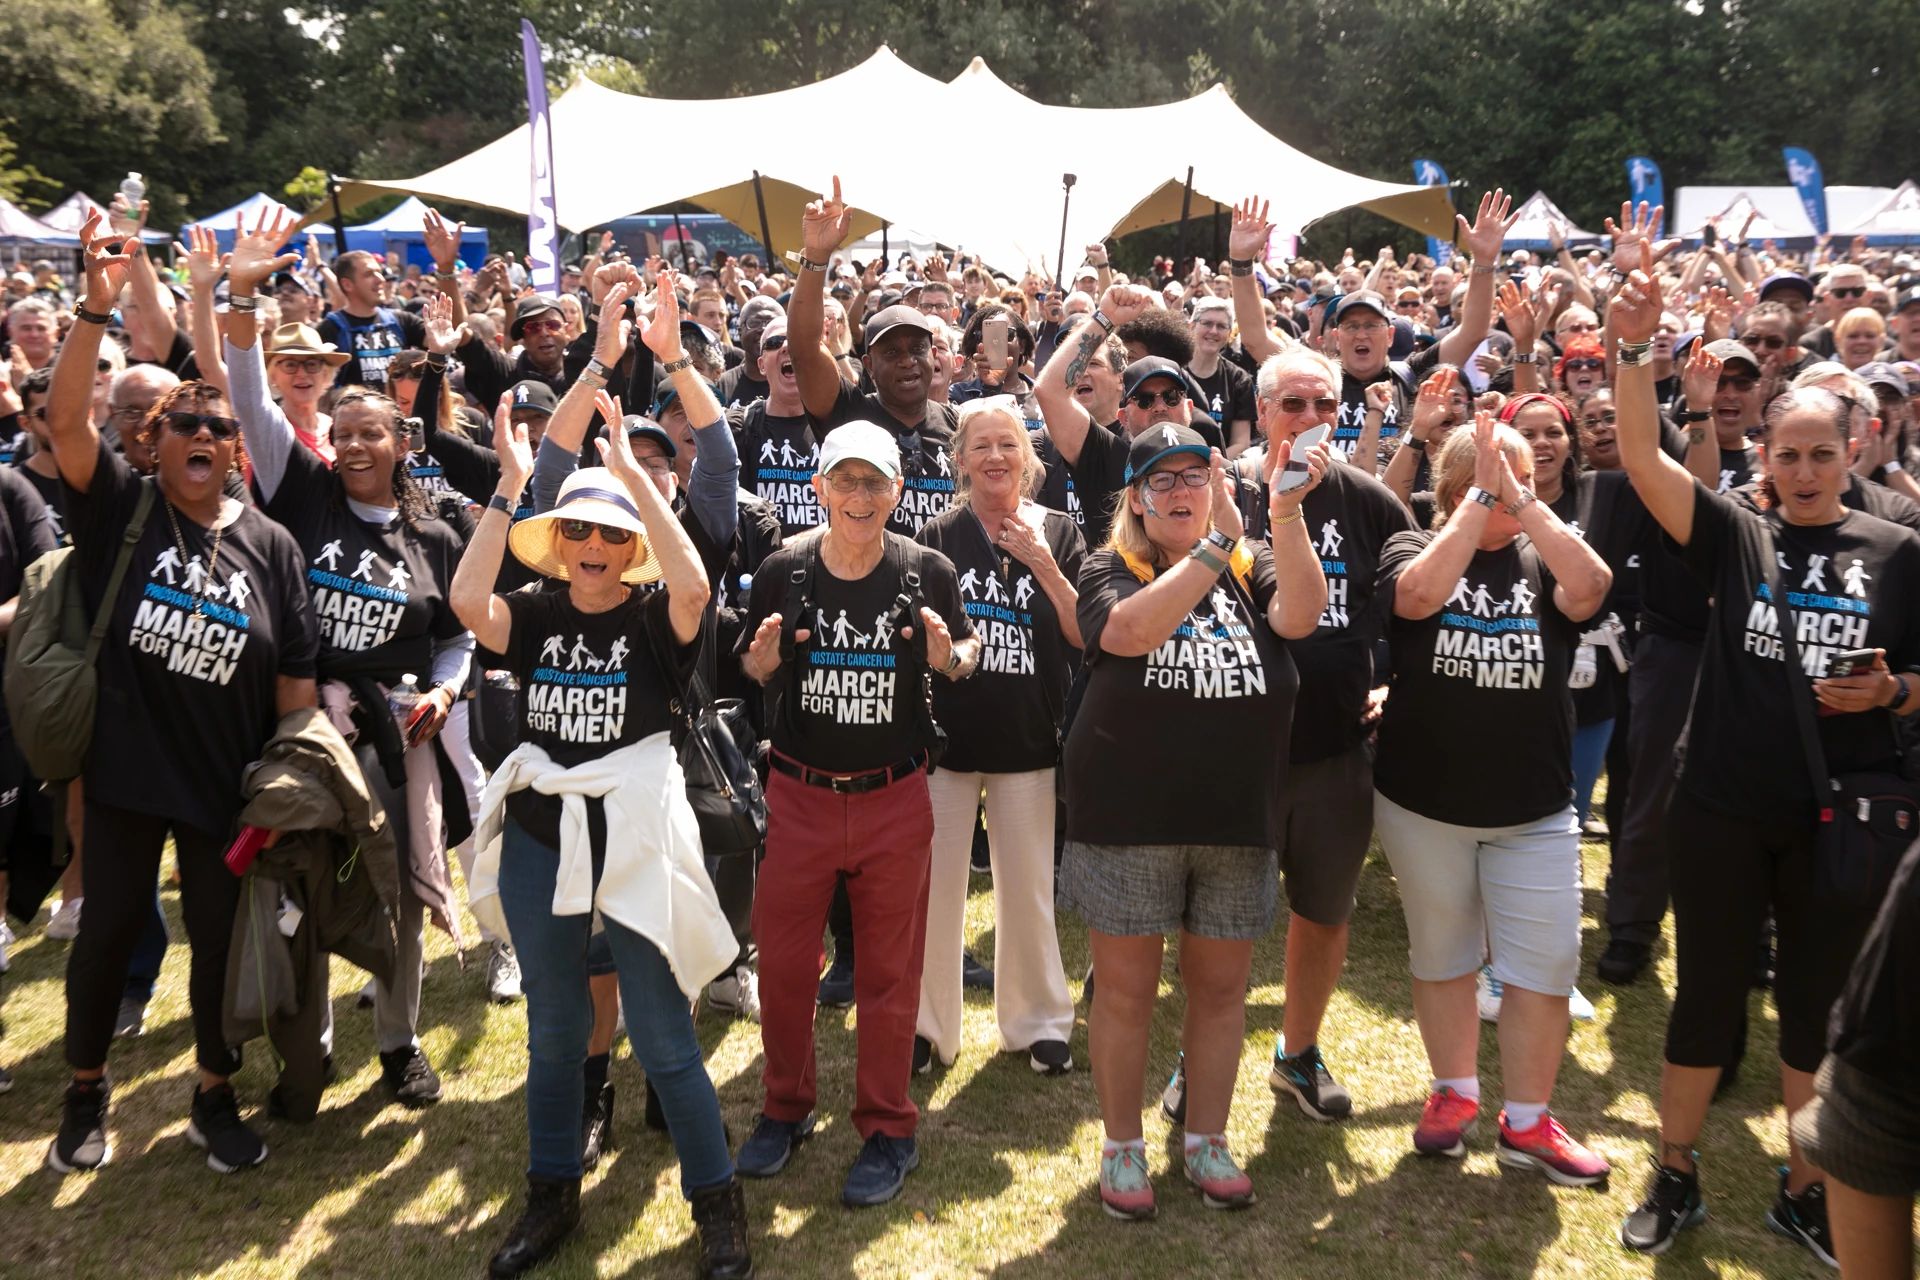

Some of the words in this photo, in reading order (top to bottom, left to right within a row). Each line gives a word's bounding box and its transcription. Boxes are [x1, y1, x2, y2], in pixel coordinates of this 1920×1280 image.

[360, 355, 396, 370] MAR
[757, 468, 791, 480] PROSTATE
[919, 478, 946, 490] CANCER
[757, 482, 820, 505] MARC
[902, 489, 956, 516] ARCH
[787, 504, 828, 526] MEN
[890, 506, 913, 528] OR
[309, 568, 353, 592] PROSTATE
[354, 581, 393, 599] CANCER
[964, 601, 995, 617] OSTATE
[132, 599, 248, 661] MARCH
[331, 621, 396, 652] MEN
[974, 619, 1034, 650] ARCH
[1234, 625, 1251, 637] UK
[1746, 601, 1869, 649] MRCH
[128, 628, 171, 658] FOR
[166, 642, 238, 686] MEN
[1147, 640, 1262, 669] MARCH
[1433, 629, 1545, 661] MARCH
[1744, 631, 1786, 662] FOR
[847, 653, 882, 668] CANCER
[884, 654, 896, 668] UK
[982, 646, 1035, 676] MEN
[1432, 656, 1474, 679] FOR
[1476, 661, 1545, 690] MEN
[614, 671, 628, 683] UK
[801, 668, 896, 698] MARCH
[1143, 667, 1189, 690] FOR
[1193, 666, 1267, 699] MEN
[528, 683, 627, 715] MARCH
[801, 694, 834, 715] FOR
[836, 698, 894, 725] MEN
[527, 711, 557, 733] FOR
[560, 714, 624, 743] MEN
